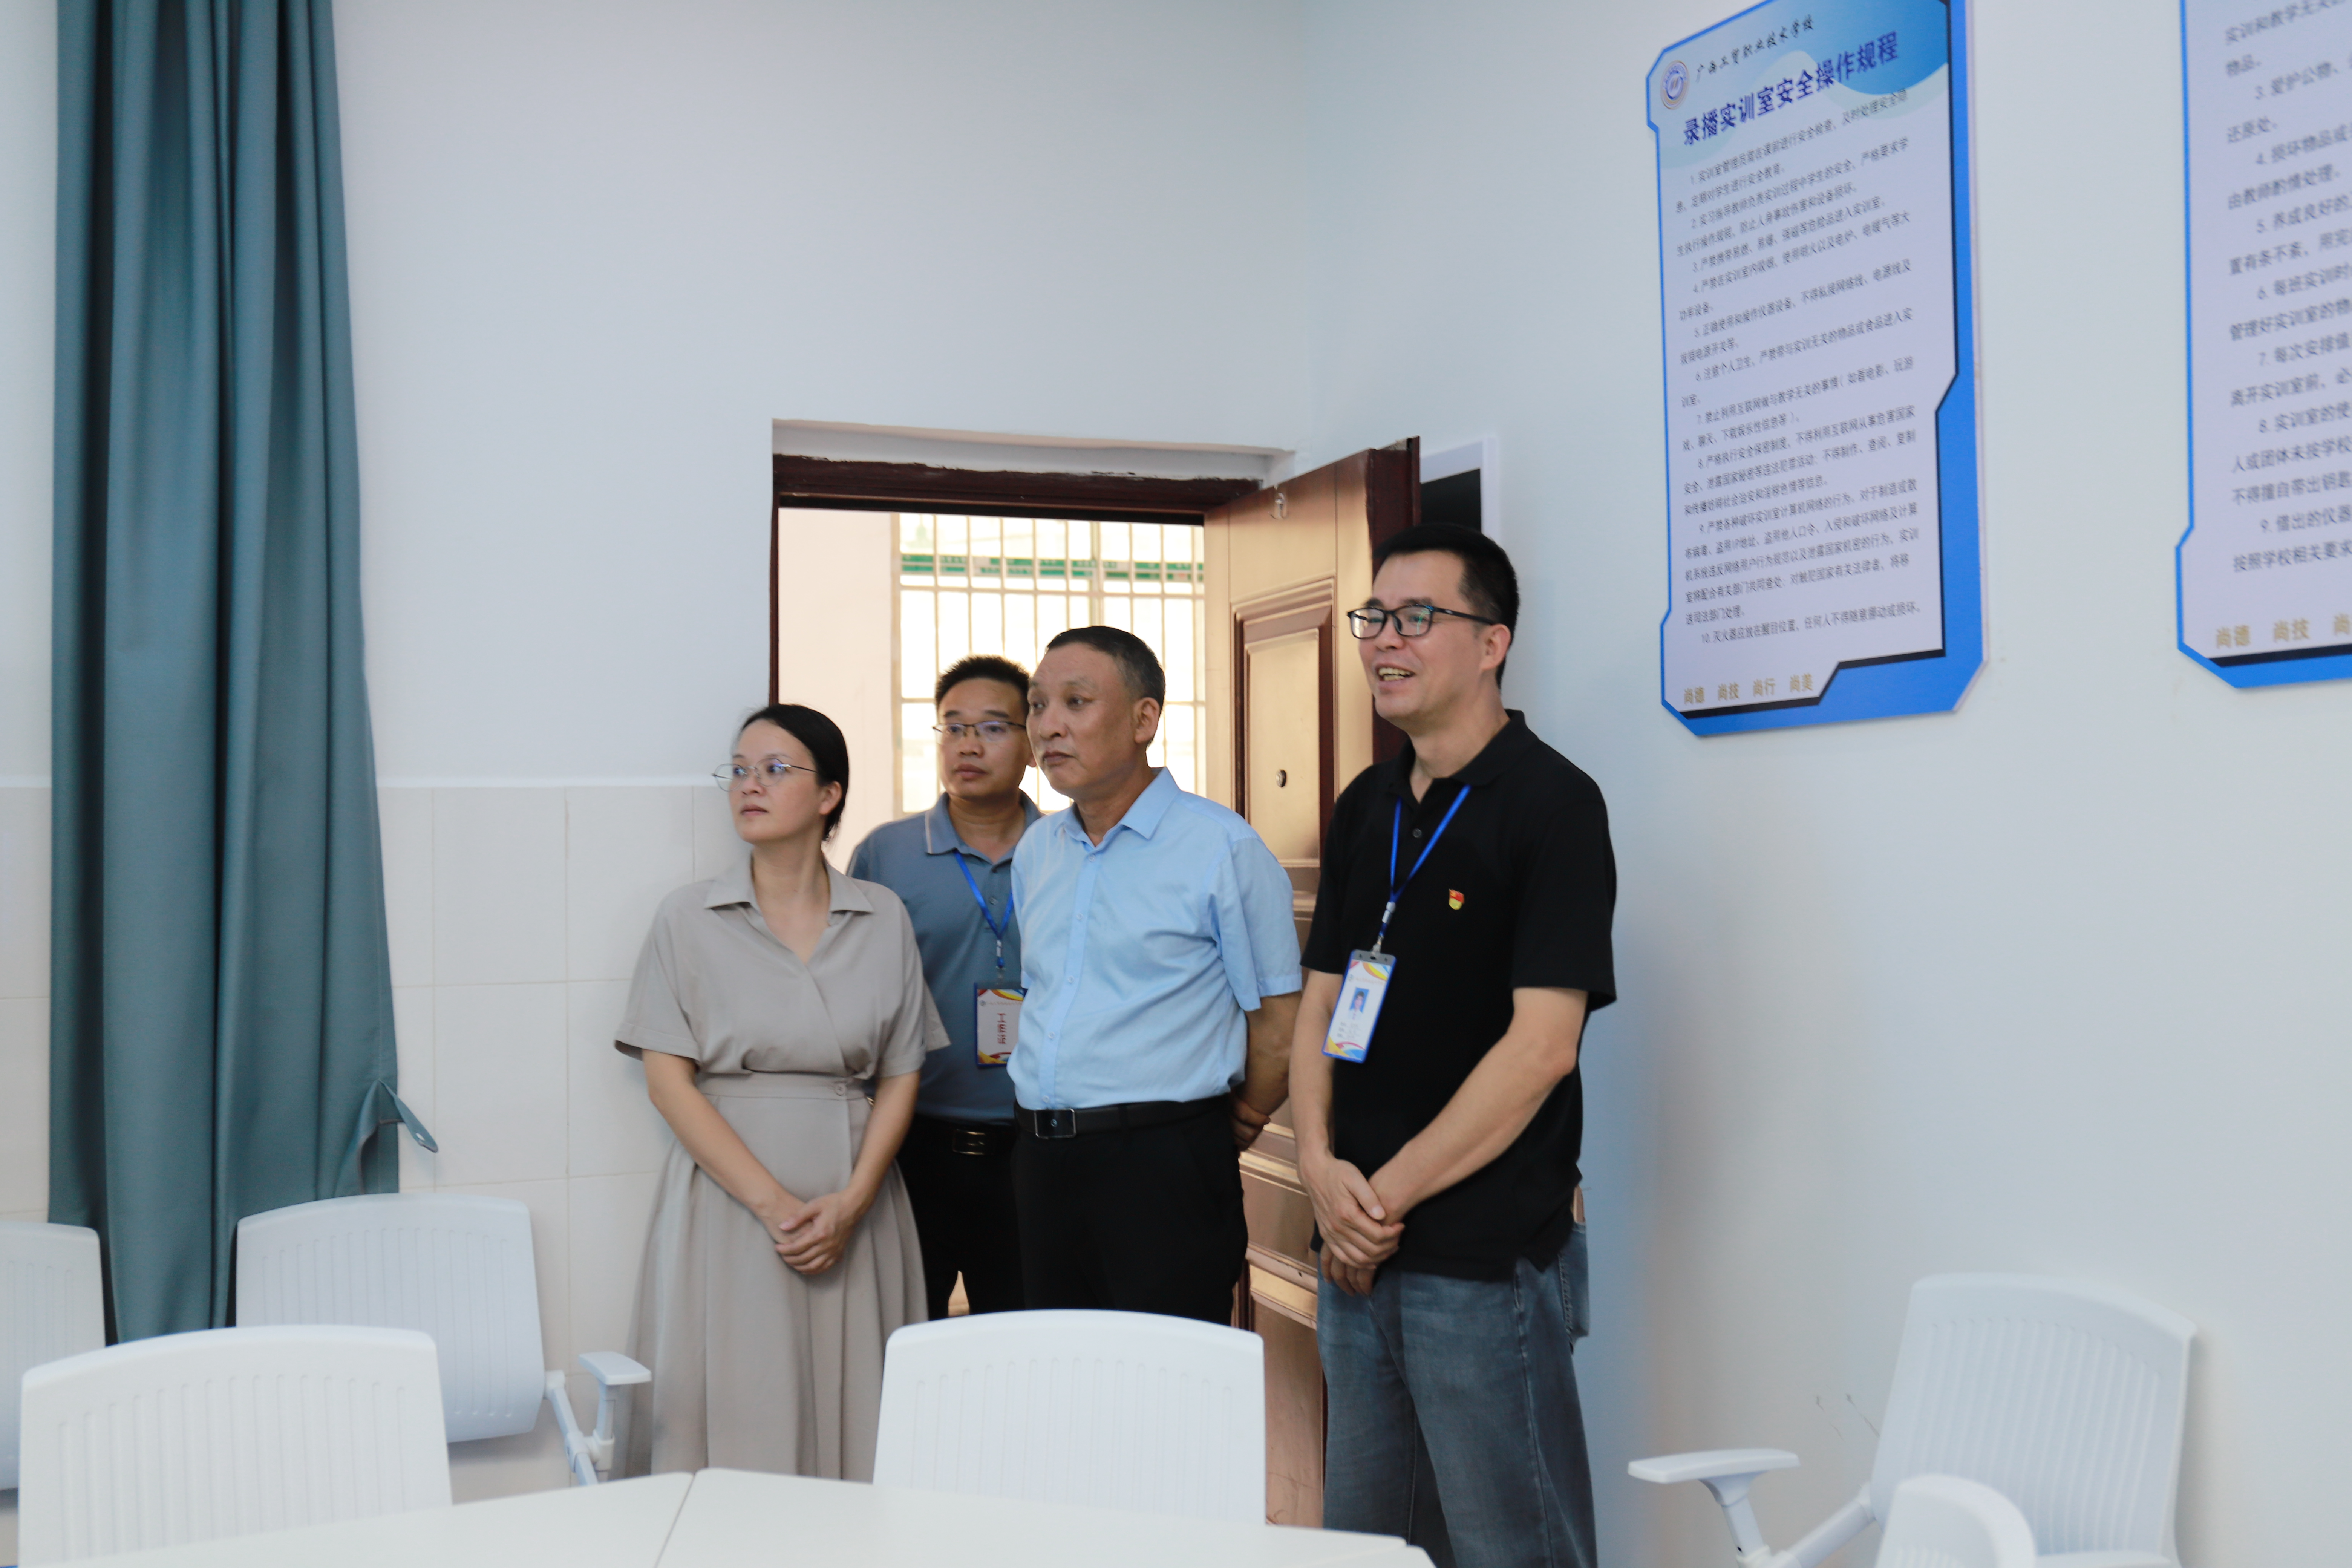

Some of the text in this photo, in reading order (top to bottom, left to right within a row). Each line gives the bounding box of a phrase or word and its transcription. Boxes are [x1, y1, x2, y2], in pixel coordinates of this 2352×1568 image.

[1683, 30, 1898, 146] 录播实训室安全操作规程
[1684, 672, 1813, 705] 尚德 尚技 尚行 尚美
[997, 1013, 1007, 1044] 工作证
